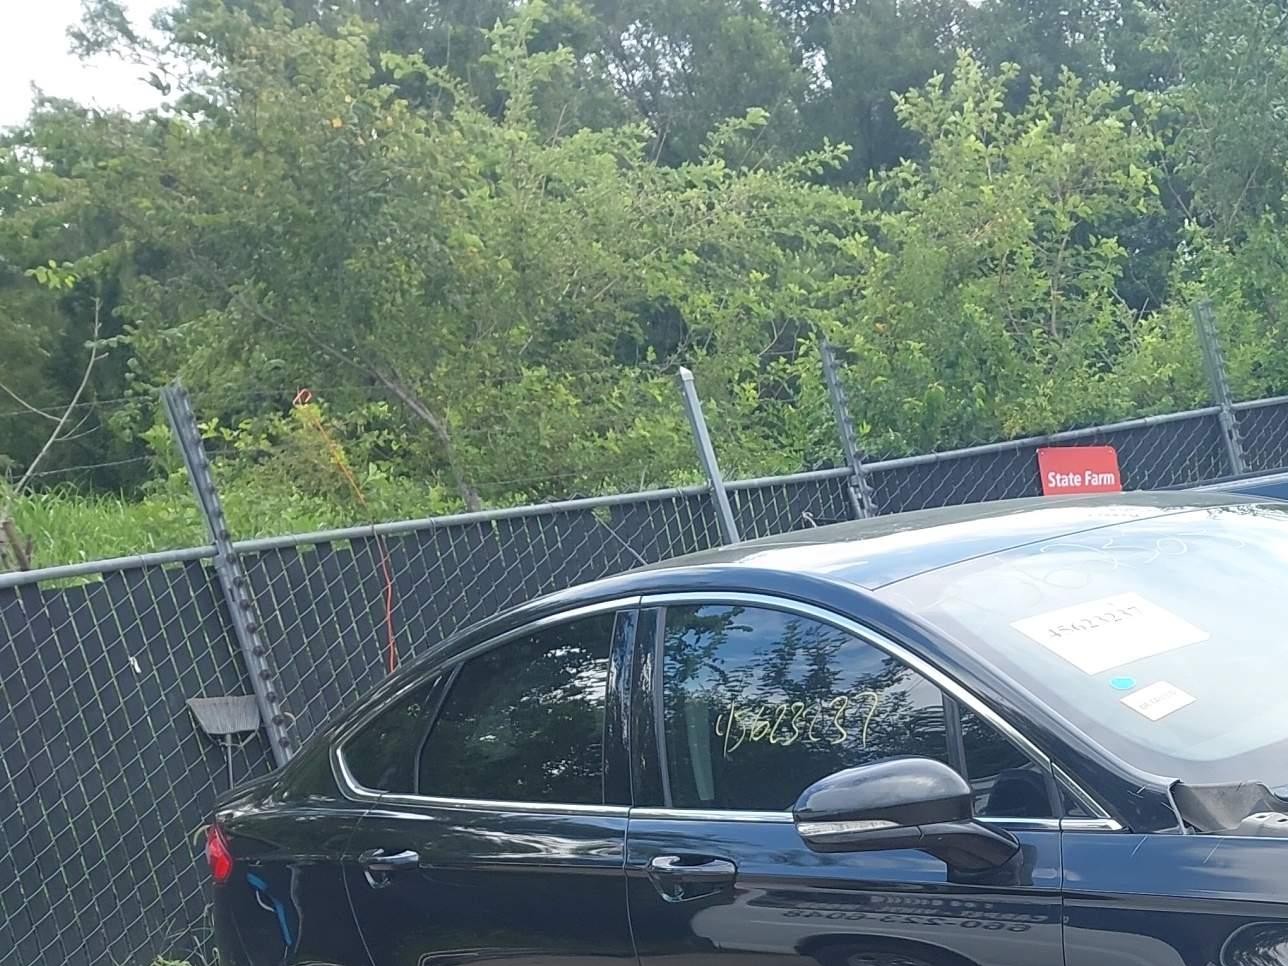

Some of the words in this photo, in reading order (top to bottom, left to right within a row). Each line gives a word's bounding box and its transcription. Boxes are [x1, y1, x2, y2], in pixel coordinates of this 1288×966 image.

[1048, 471, 1082, 487] State
[1084, 470, 1115, 486] Farm
[716, 691, 878, 757] 45623237
